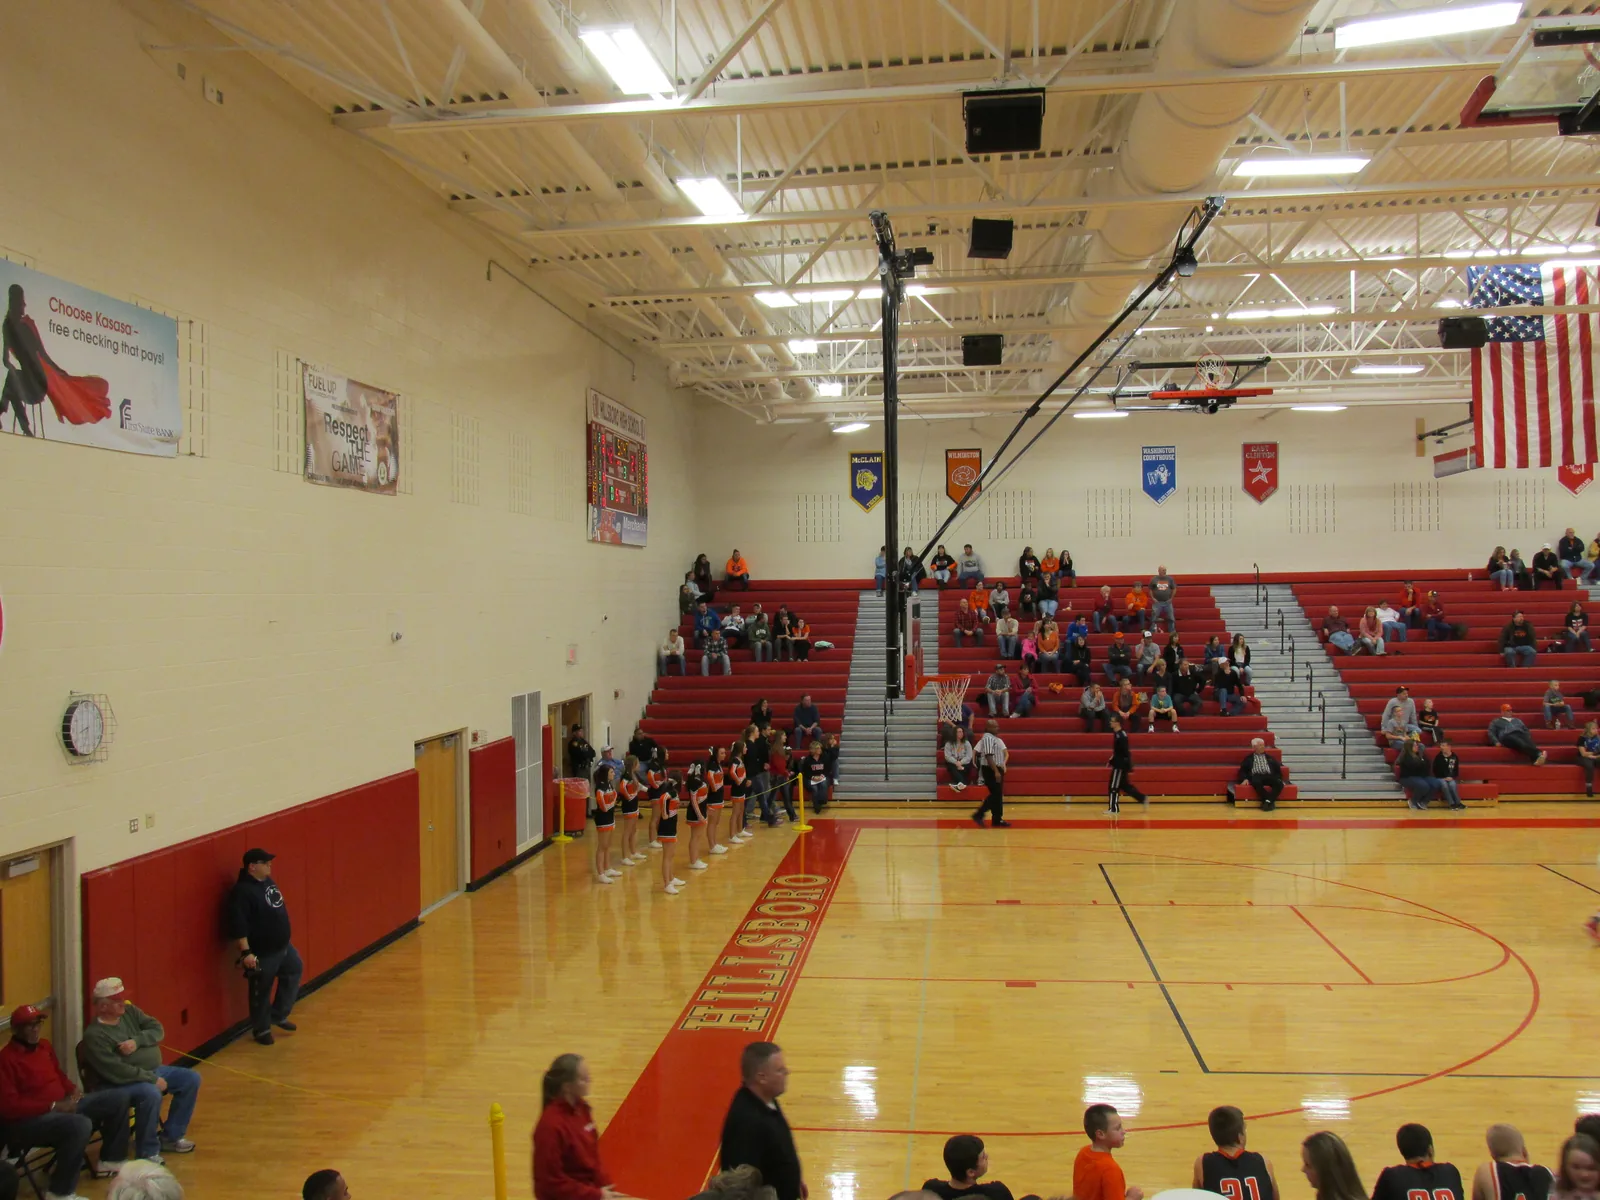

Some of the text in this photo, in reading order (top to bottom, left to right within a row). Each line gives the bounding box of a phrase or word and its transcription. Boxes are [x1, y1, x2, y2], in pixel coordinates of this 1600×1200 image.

[49, 296, 93, 323] Choose
[49, 319, 165, 365] free checking that pays!
[307, 373, 327, 392] FUEL
[324, 412, 369, 443] Respect
[348, 439, 371, 462] THE
[947, 451, 980, 459] WILMINGTON
[331, 451, 365, 477] GAME
[677, 873, 832, 1032] HILLSBORO
